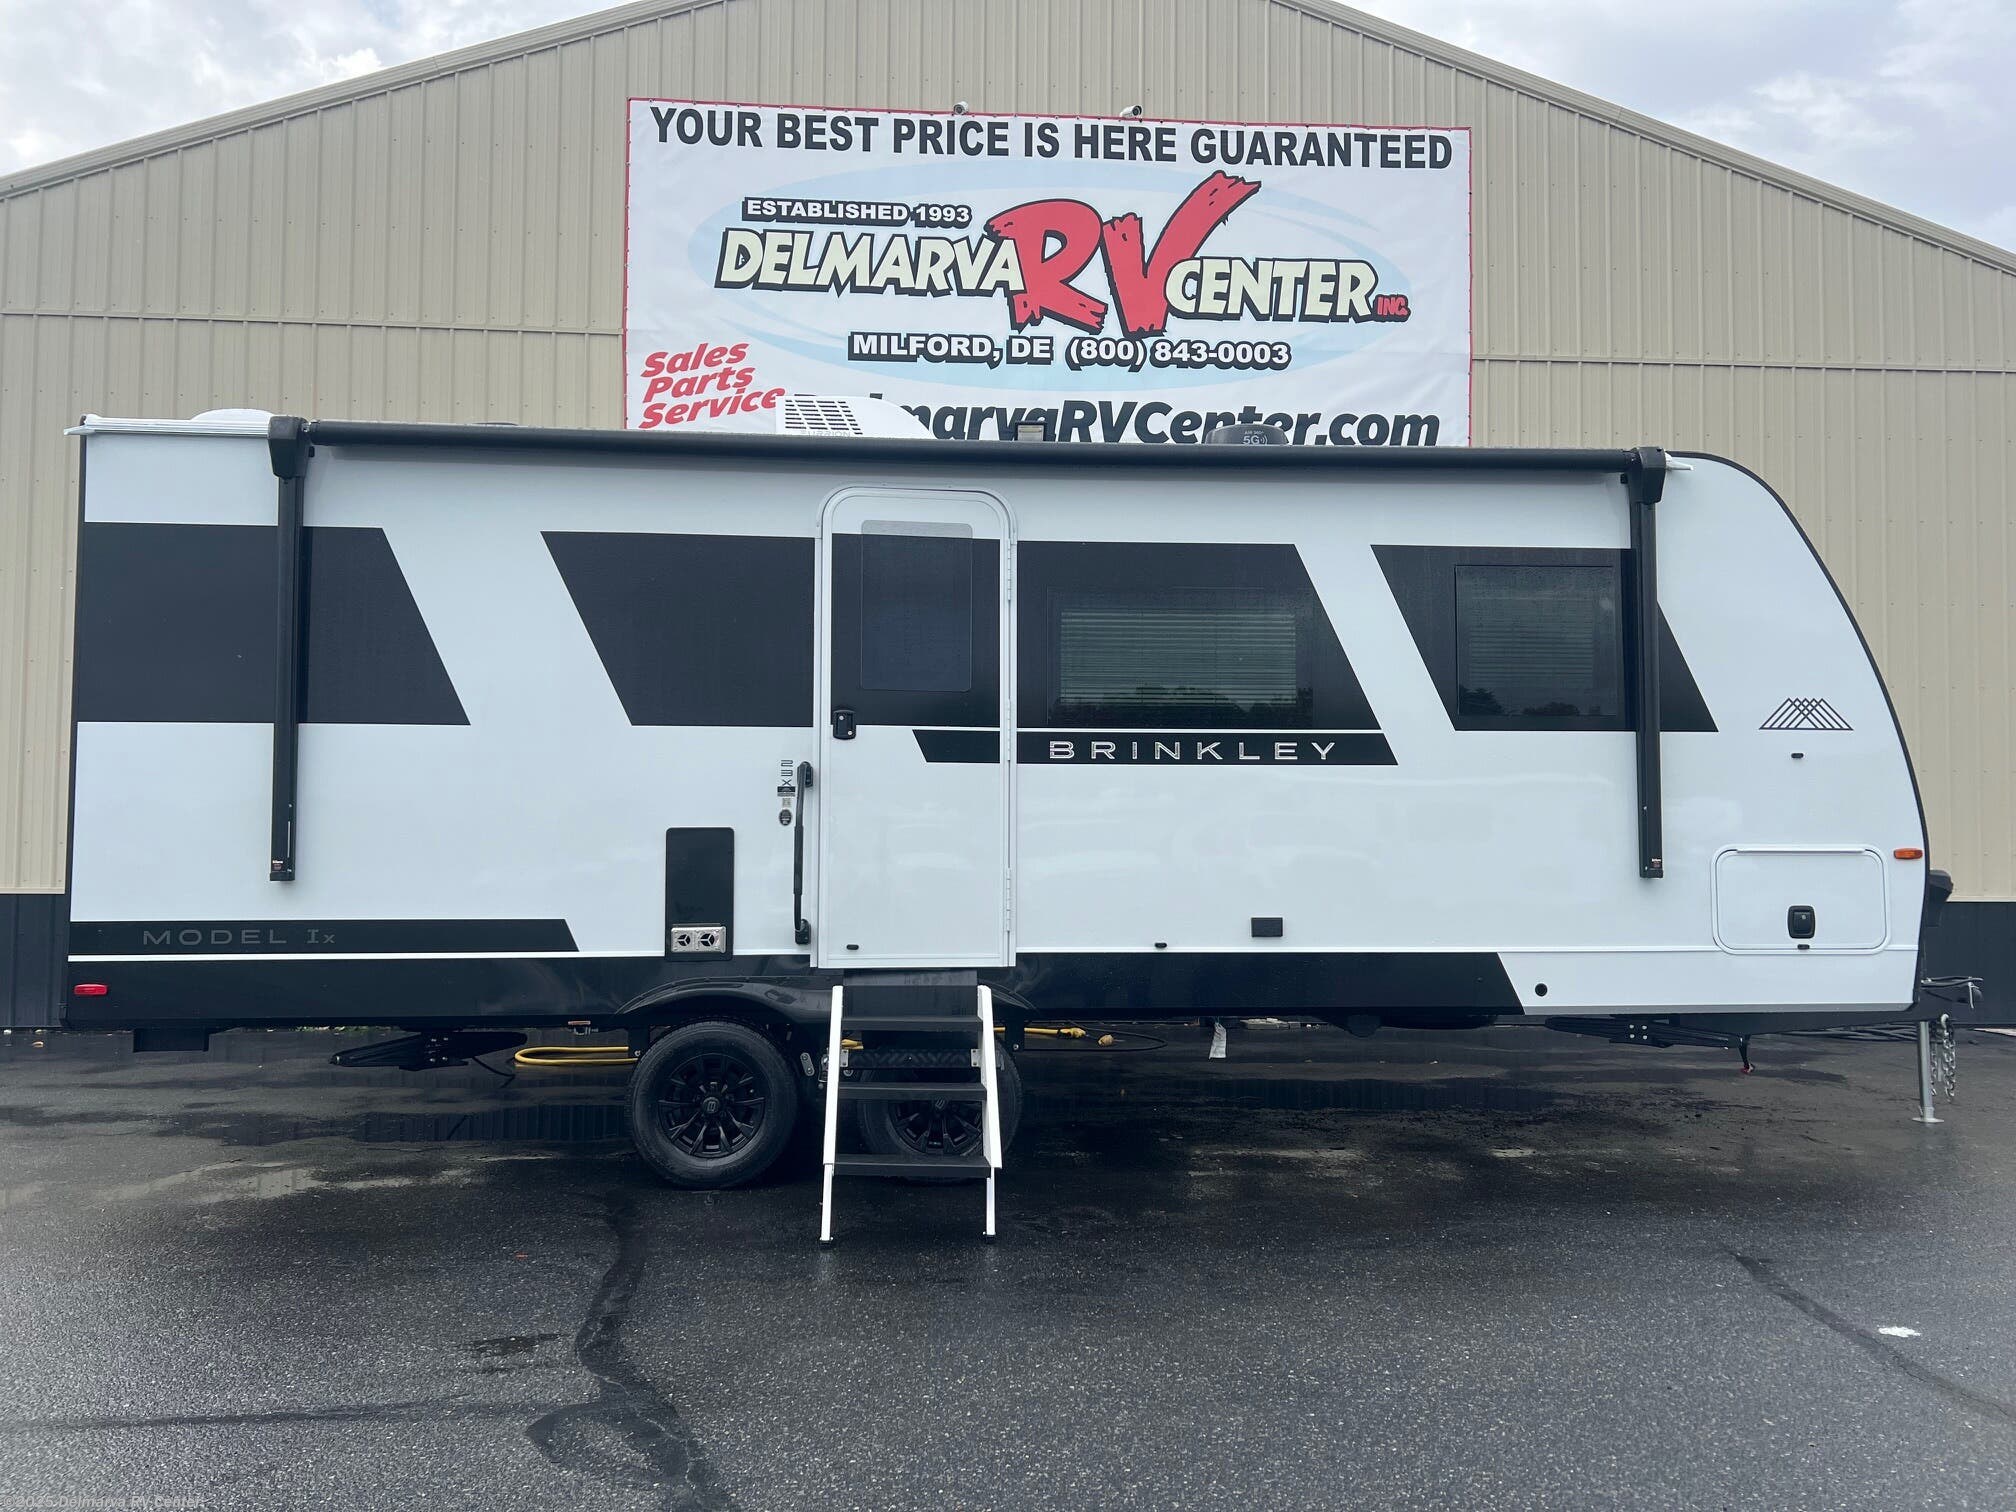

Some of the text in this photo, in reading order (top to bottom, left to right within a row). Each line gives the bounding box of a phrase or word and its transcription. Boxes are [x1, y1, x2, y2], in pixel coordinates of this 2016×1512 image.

[650, 107, 1452, 169] YOUR BEST PRICE IS HERE GUARANTEED
[744, 198, 971, 225] ESTABLISHED 1993
[715, 227, 1025, 299] DELMARVA
[983, 170, 1262, 337] RV
[1165, 256, 1378, 322] CENTER
[641, 343, 749, 378] Sales
[850, 332, 1291, 370] MILFORD, DE (800) 843-0003
[643, 366, 755, 403] Parts
[639, 387, 786, 429] Service
[1049, 740, 1335, 760] BRINKLEY
[143, 929, 287, 945] MODEL
